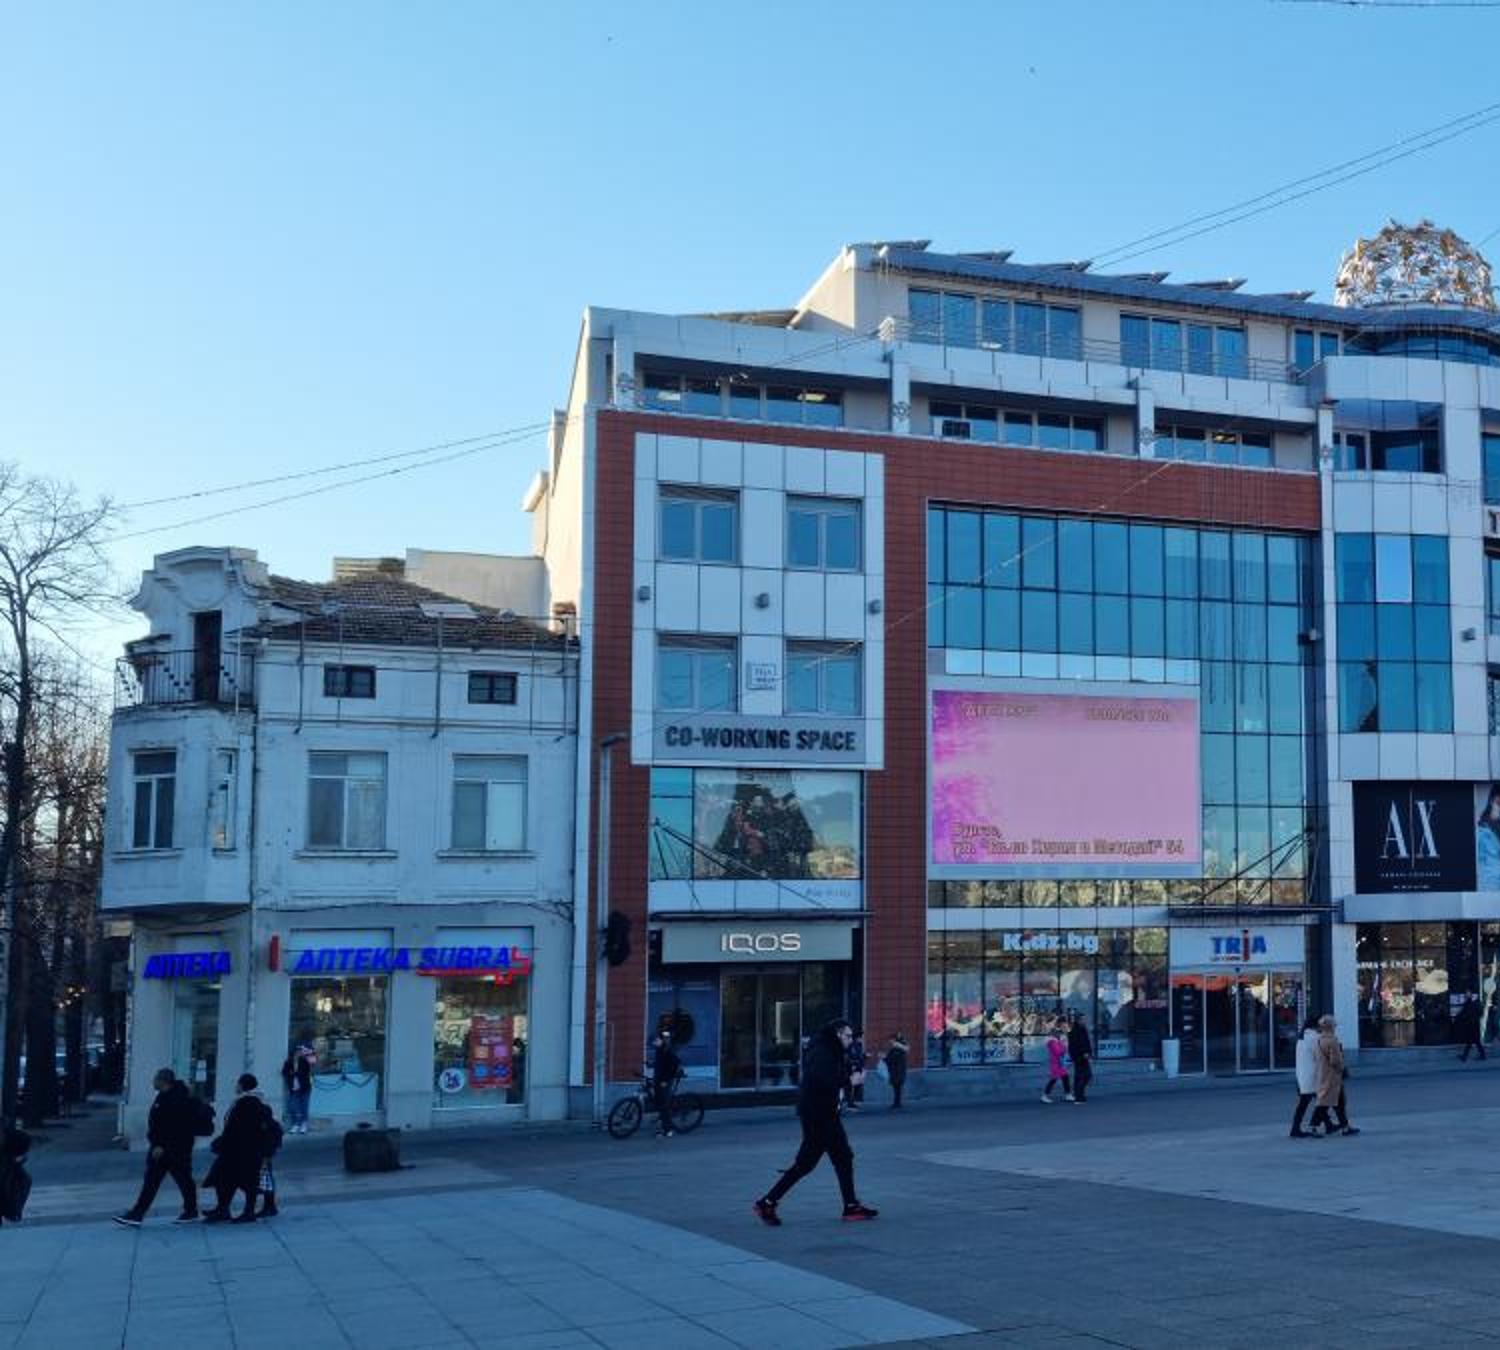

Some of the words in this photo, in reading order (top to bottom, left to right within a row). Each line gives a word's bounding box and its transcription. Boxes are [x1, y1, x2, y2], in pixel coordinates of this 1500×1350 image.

[665, 726, 791, 750] CO-WORKING
[796, 729, 857, 751] SPACE
[721, 933, 801, 954] IQOS
[295, 947, 411, 973] АПТЕКА
[420, 946, 511, 970] SUBRA
